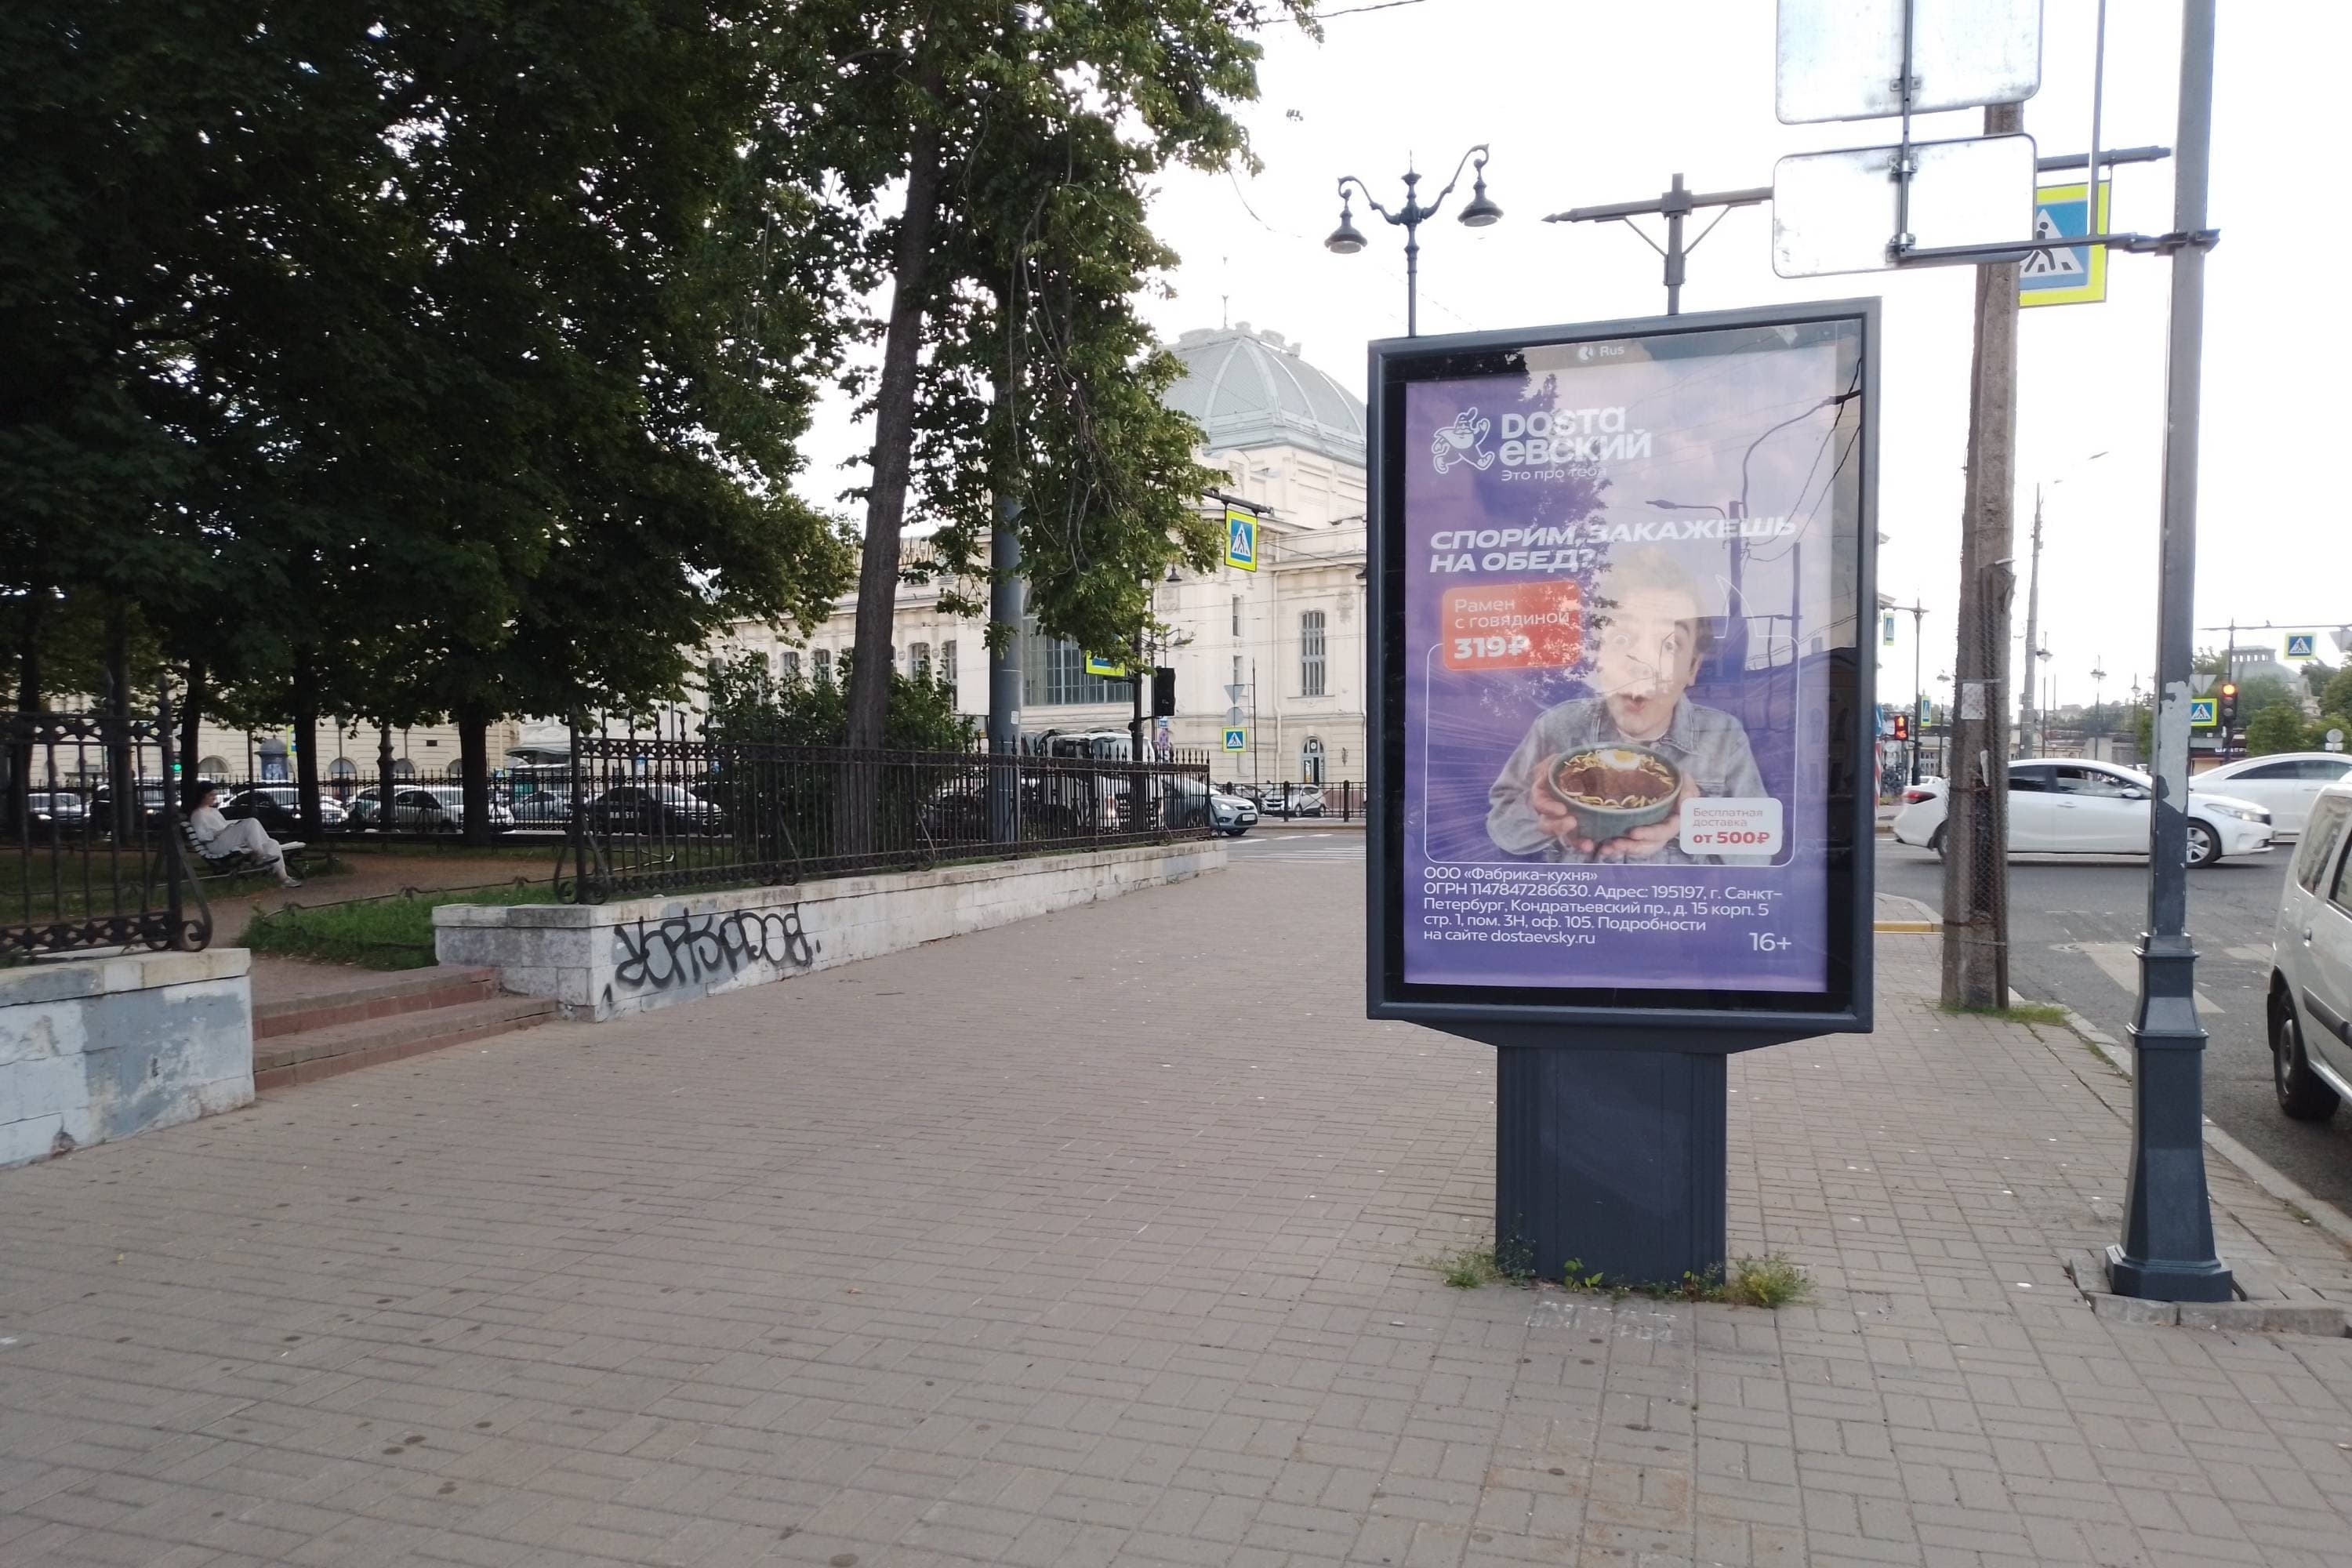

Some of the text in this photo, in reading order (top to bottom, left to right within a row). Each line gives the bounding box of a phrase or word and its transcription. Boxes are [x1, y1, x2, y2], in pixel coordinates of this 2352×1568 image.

[1600, 346, 1624, 357] Rus
[1501, 470, 1531, 481] Это
[1534, 469, 1565, 481] про
[1430, 516, 1797, 550] СПОРИМ, ЗАКАЖЕШЬ
[1429, 548, 1596, 573] НА ОБЕД?
[1454, 598, 1515, 613] Рамен
[1454, 611, 1570, 629] с говядиной
[1693, 808, 1763, 817] Бесплатная
[1693, 834, 1712, 844] от
[1424, 866, 1461, 879] ООО
[1424, 882, 1784, 901] ОГРН 1147847286630. Адрес: 195197, г. Санкт-
[1424, 898, 1769, 918] Петербург, Кондратьевский пр., д. 15 корп. 5
[1424, 913, 1707, 932] стр. 1, пом. 3Н, оф. 105. Подробности
[1424, 929, 1596, 946] на сайте dostaevsky.ru
[1748, 931, 1792, 952] 16+
